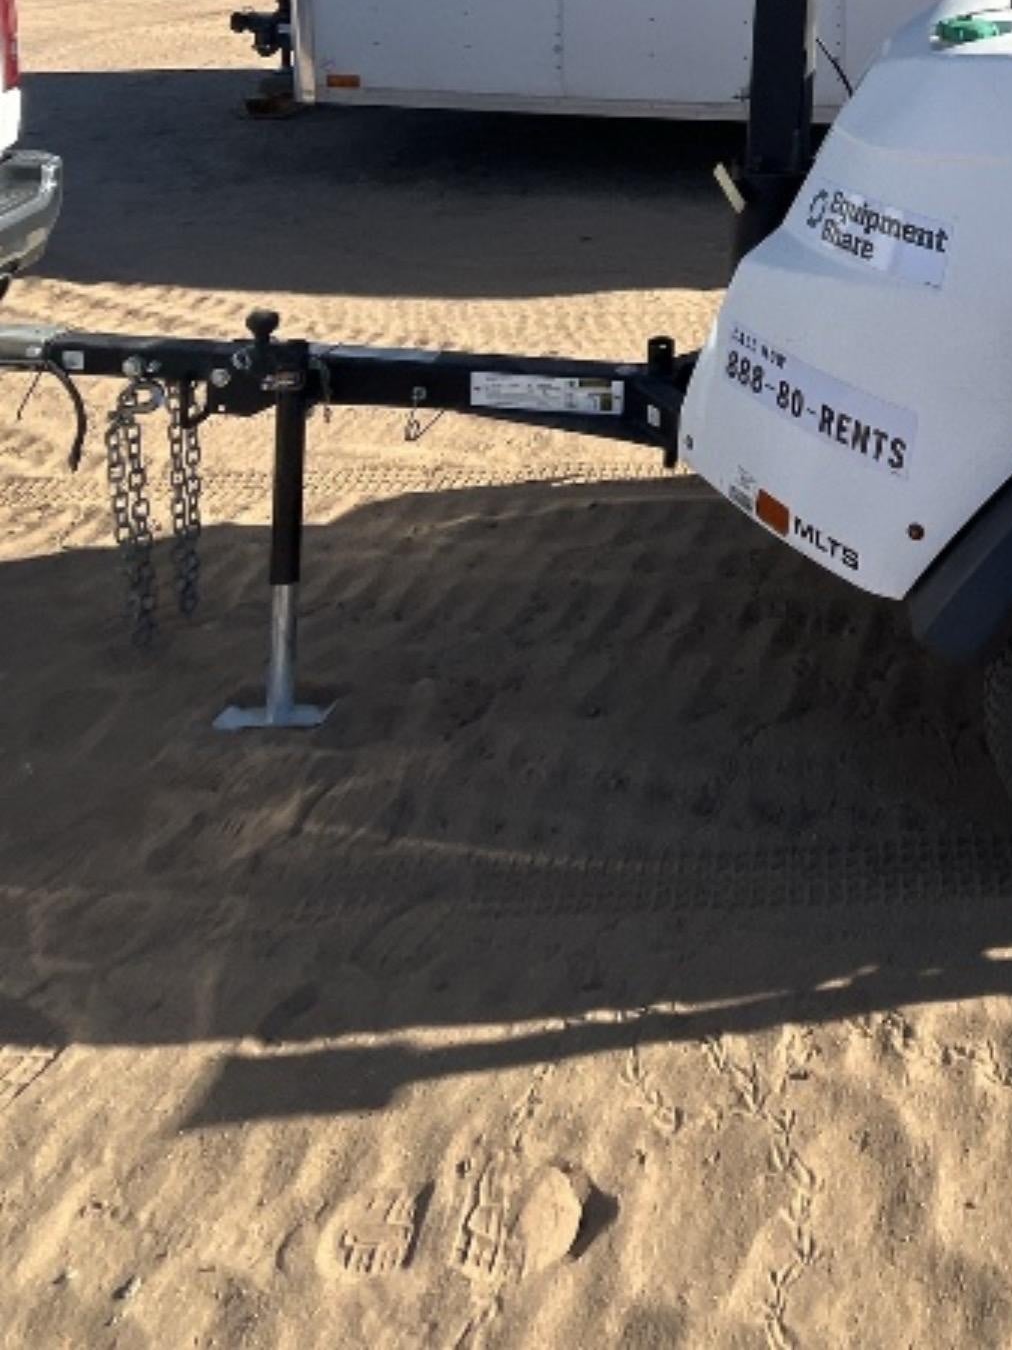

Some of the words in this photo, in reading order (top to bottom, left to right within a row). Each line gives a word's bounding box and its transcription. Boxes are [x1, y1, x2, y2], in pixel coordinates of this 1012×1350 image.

[821, 218, 875, 261] Share
[830, 191, 949, 253] Equipment
[725, 350, 907, 469] 888-80-RENTS
